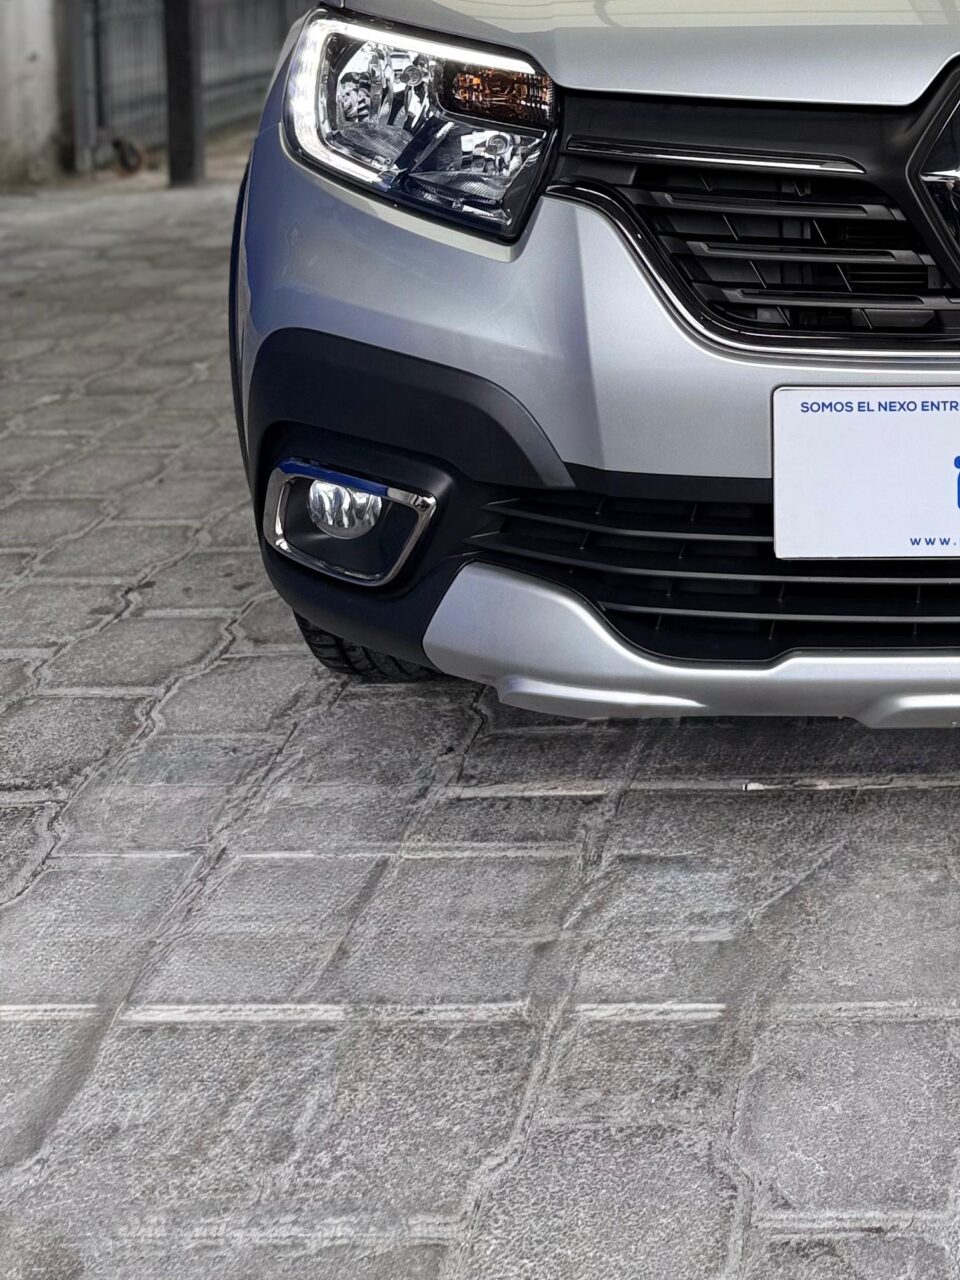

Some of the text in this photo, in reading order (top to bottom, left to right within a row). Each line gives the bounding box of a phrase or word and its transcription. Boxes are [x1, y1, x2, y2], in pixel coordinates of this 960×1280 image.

[800, 400, 854, 413] SOMOS
[857, 400, 875, 413] EL
[877, 400, 918, 412] NEXO
